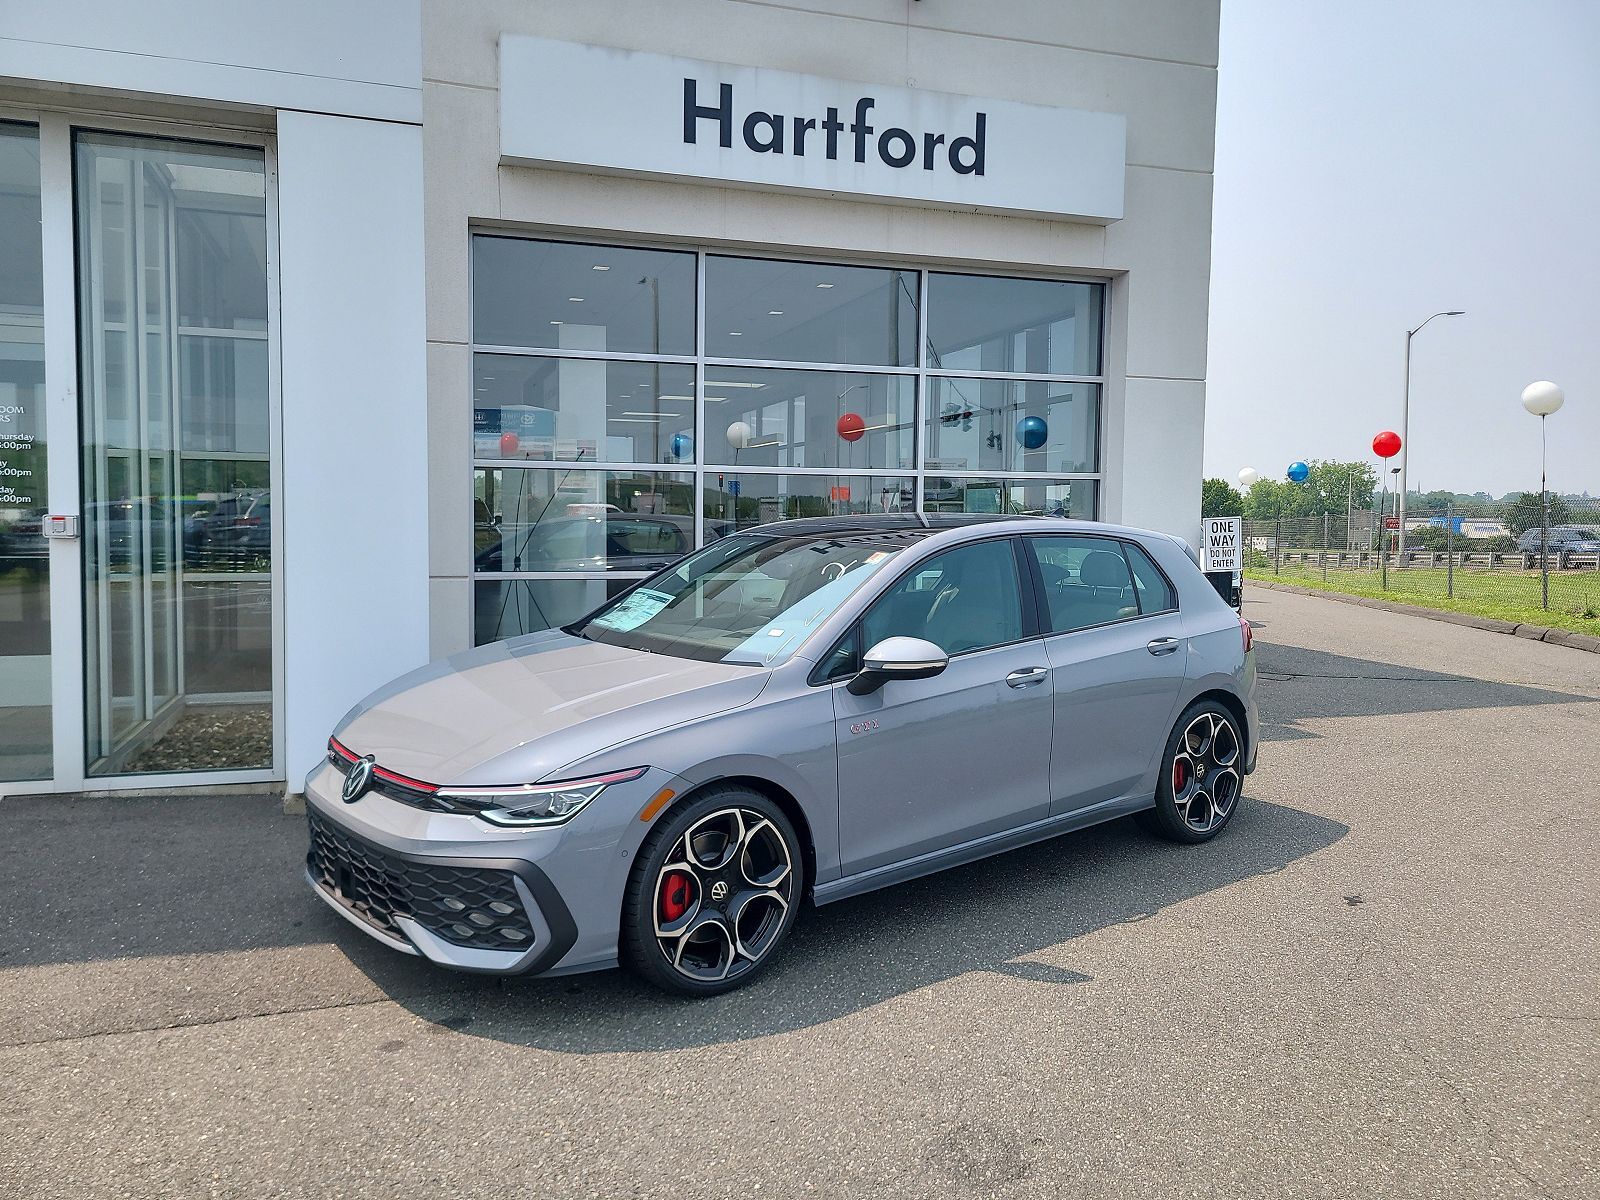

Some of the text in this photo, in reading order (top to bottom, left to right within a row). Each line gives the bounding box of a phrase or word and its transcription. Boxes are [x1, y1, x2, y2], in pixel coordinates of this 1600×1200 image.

[683, 77, 987, 176] Hartford
[0, 441, 32, 451] :00pm
[0, 468, 32, 478] :00pm
[0, 494, 32, 504] :00pm
[1211, 521, 1234, 534] ONE
[1210, 534, 1236, 547] WAY
[1210, 548, 1236, 558] DO NOT
[1212, 559, 1235, 568] ENTER
